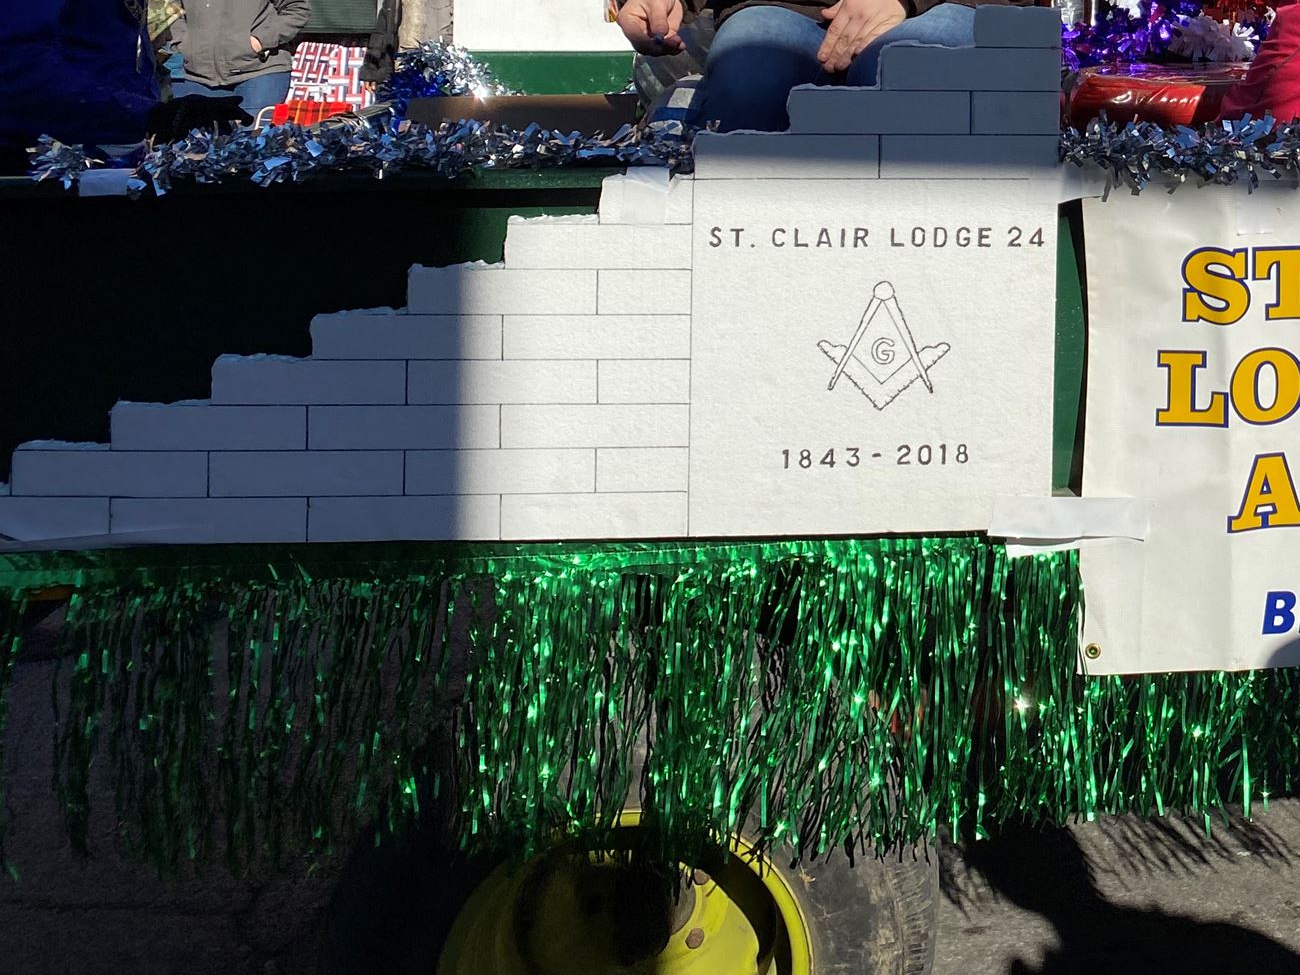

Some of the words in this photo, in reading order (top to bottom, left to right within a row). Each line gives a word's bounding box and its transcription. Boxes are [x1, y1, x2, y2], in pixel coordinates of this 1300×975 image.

[709, 226, 757, 249] ST.
[771, 227, 870, 249] CLAIR
[890, 226, 993, 248] LODGE
[1007, 226, 1046, 248] 24
[871, 337, 895, 365] G
